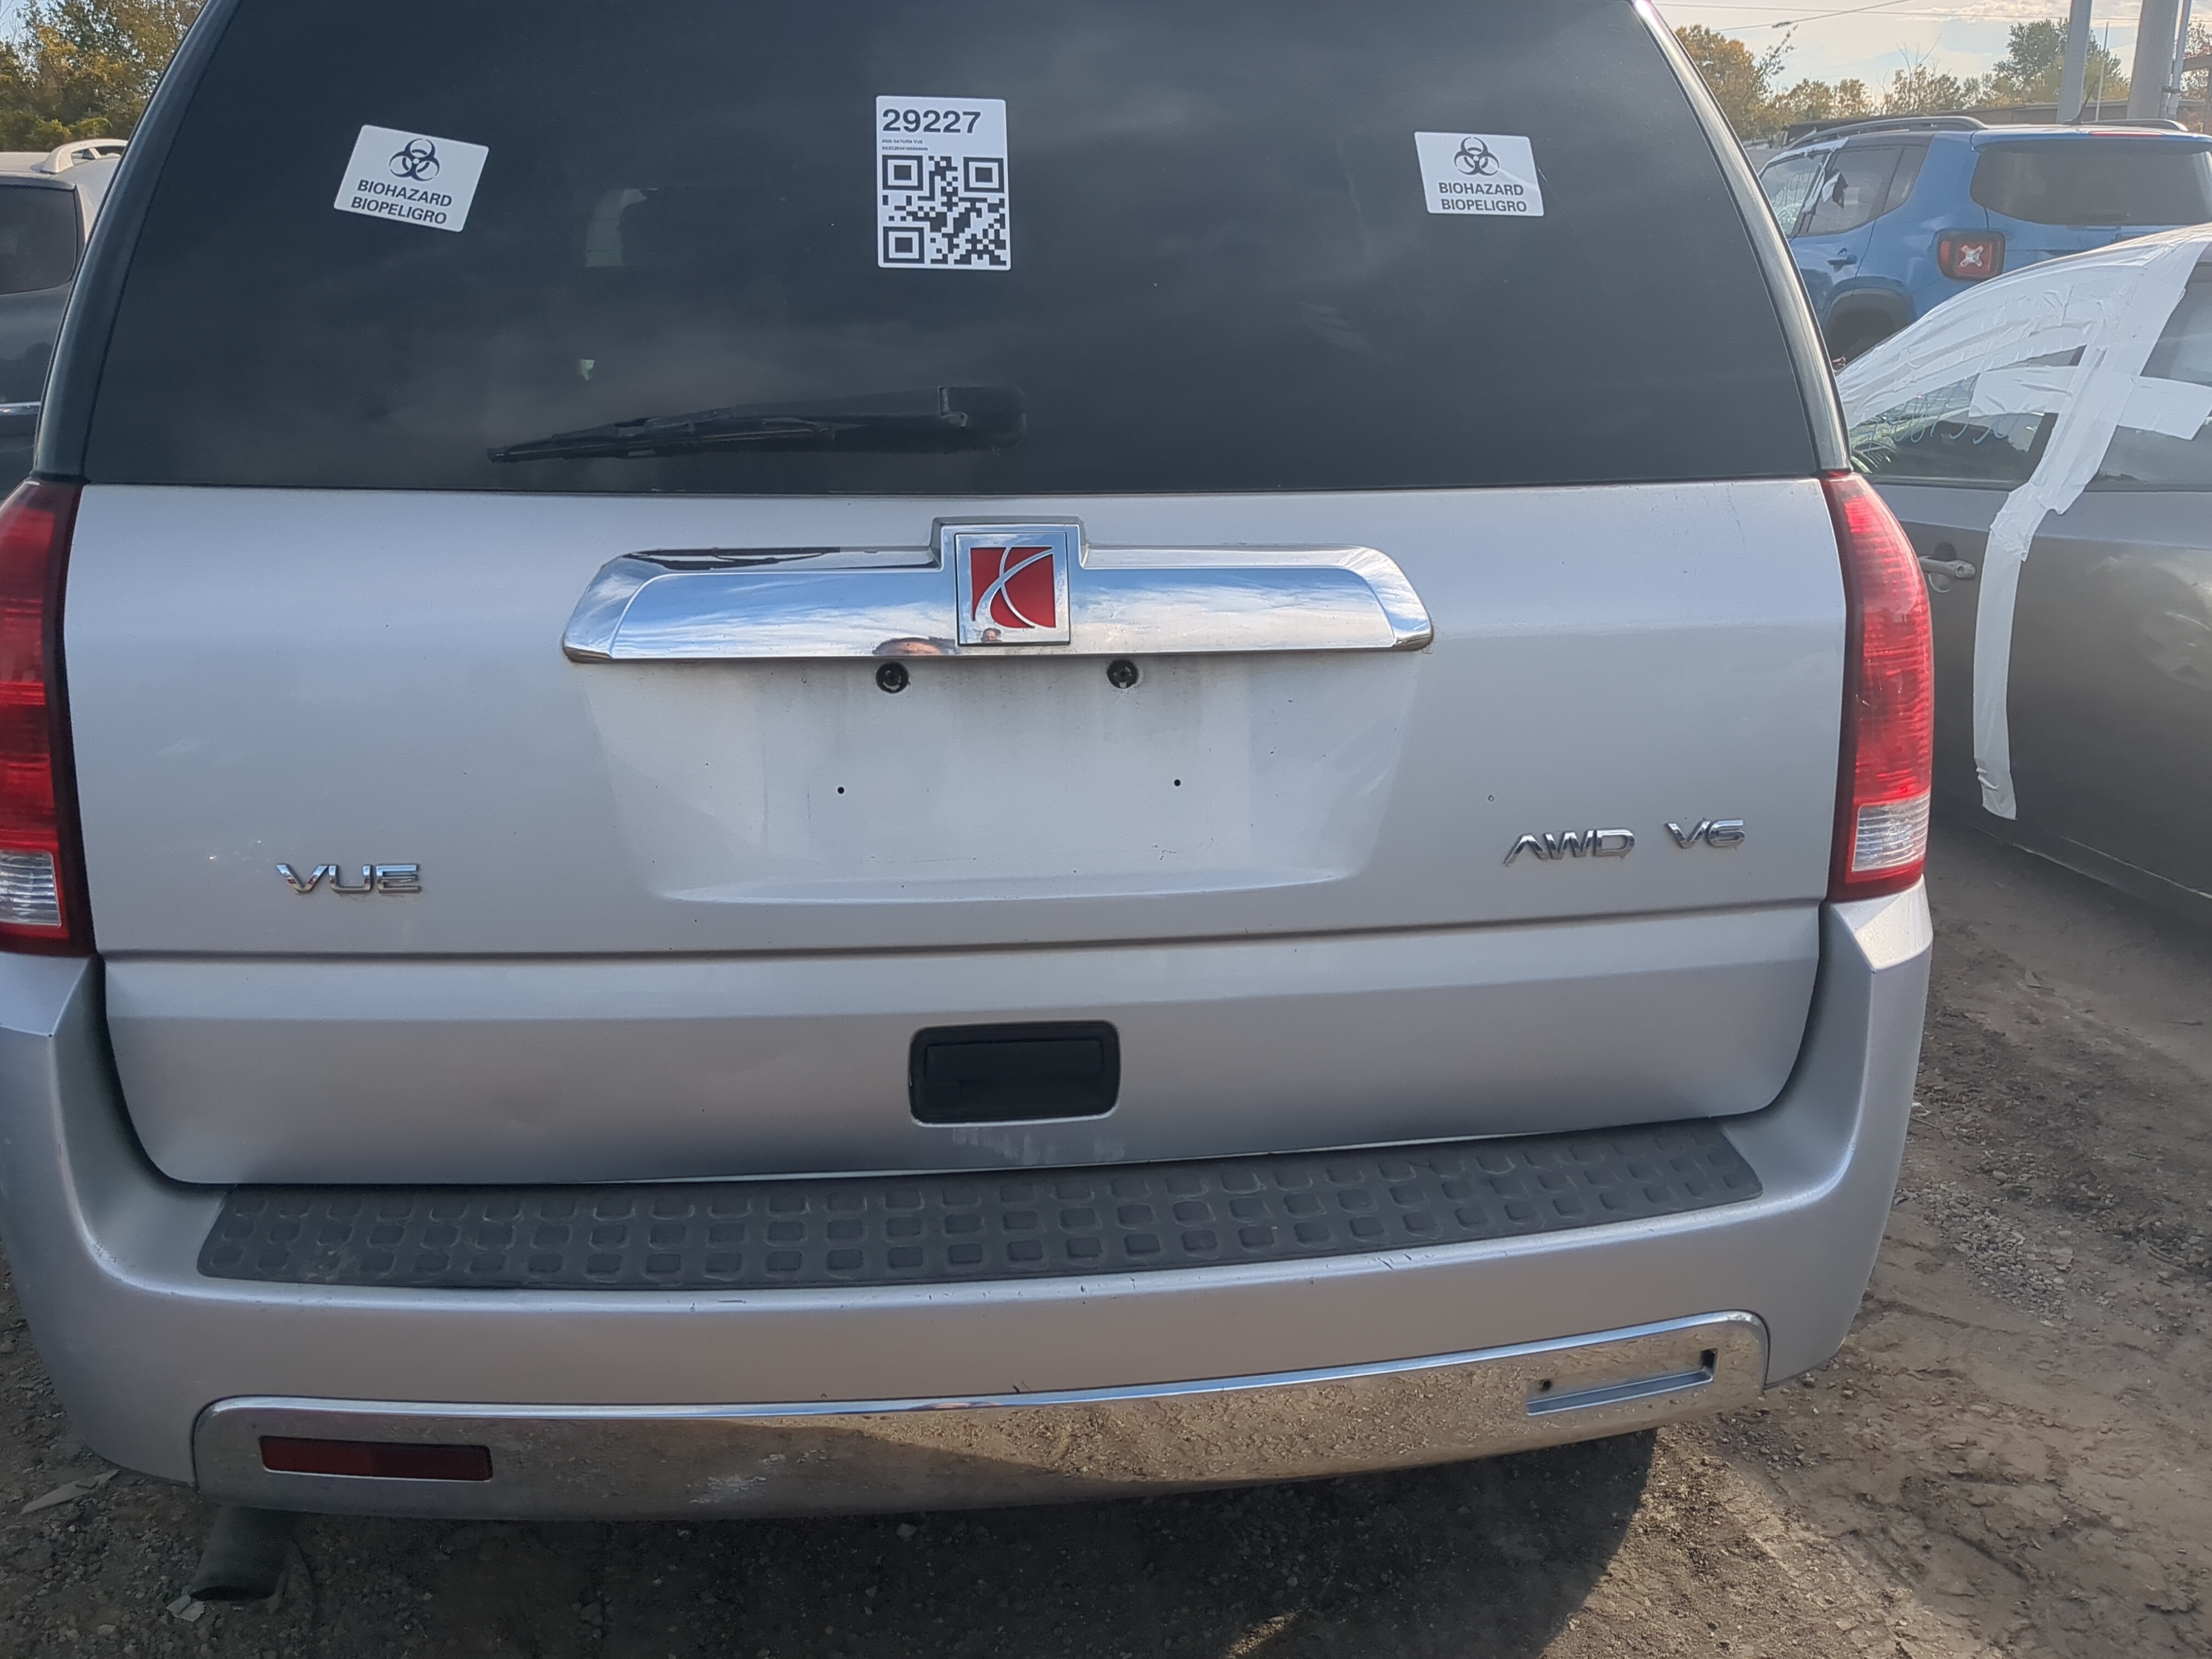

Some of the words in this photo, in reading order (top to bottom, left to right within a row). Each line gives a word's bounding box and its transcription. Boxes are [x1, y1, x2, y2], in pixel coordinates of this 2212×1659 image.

[882, 109, 981, 133] 29227
[357, 179, 453, 207] BIOHAZARD
[1438, 182, 1524, 196] BIOHAZARD
[351, 196, 447, 224] BIOPELIGRO
[1441, 199, 1527, 212] BIOPELIGRO
[1503, 828, 1635, 865] AWD
[1664, 818, 1746, 850] V6
[276, 863, 421, 895] VUE
